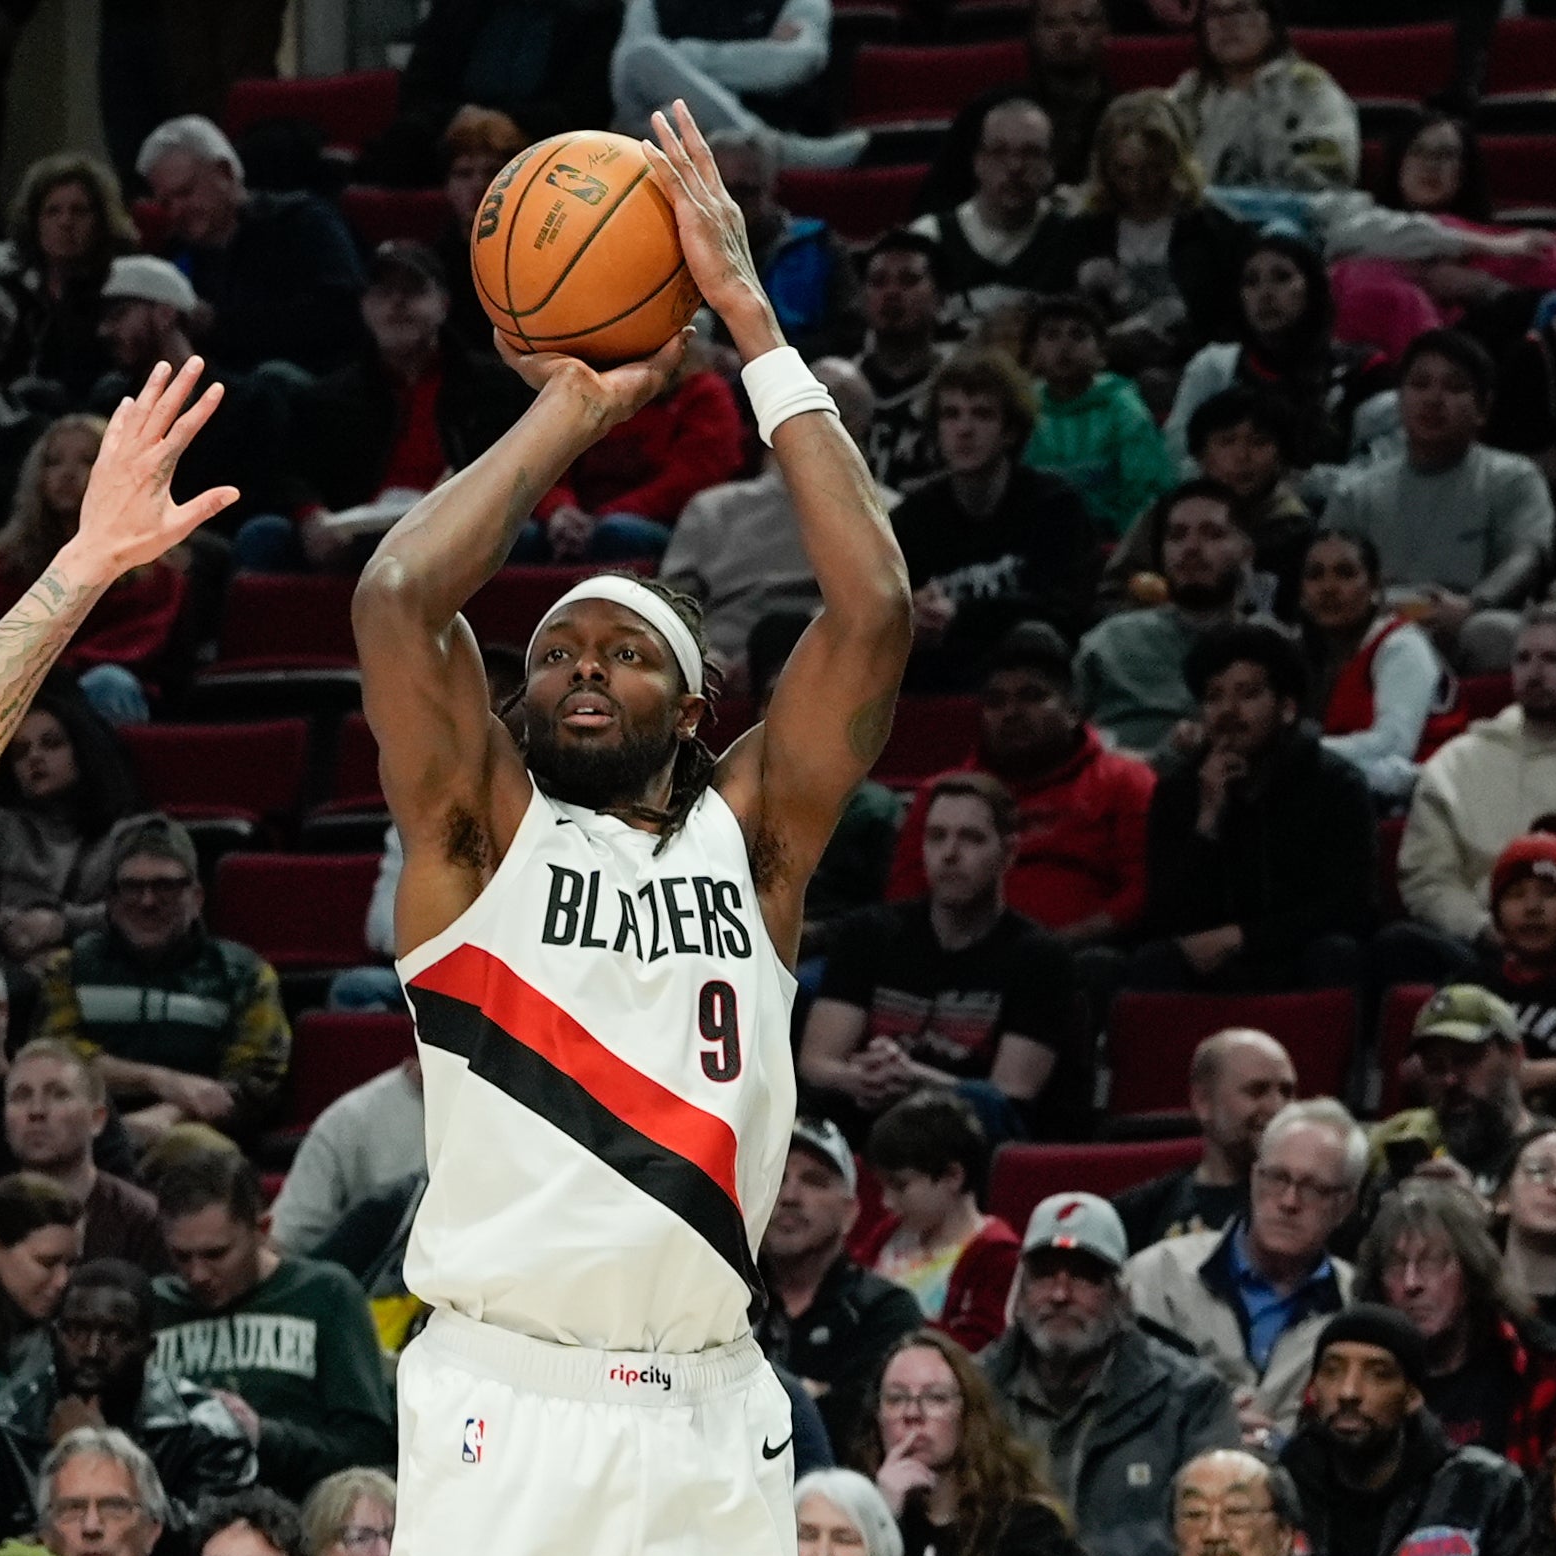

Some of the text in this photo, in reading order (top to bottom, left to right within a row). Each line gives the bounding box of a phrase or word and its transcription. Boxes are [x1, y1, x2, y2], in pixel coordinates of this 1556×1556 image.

[542, 862, 752, 963] BLAZERS
[698, 980, 742, 1083] 9
[151, 1312, 317, 1379] ILWAUKEE
